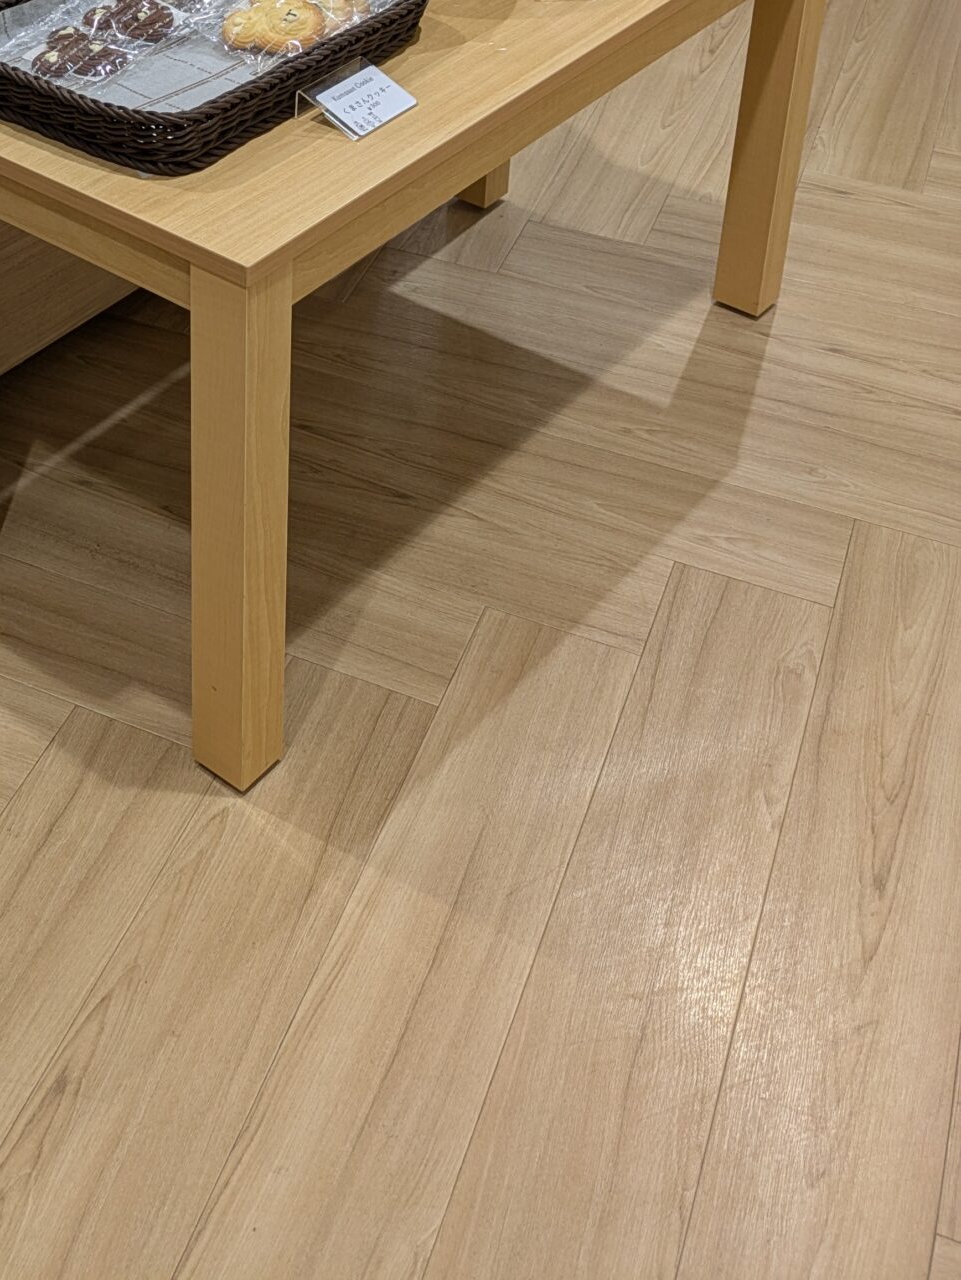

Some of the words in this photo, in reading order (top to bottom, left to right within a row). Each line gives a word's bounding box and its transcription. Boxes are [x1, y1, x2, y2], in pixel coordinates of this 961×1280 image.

[332, 87, 357, 102] Kumasan
[354, 76, 374, 89] Cookie
[343, 84, 391, 114] くまさんクッキー
